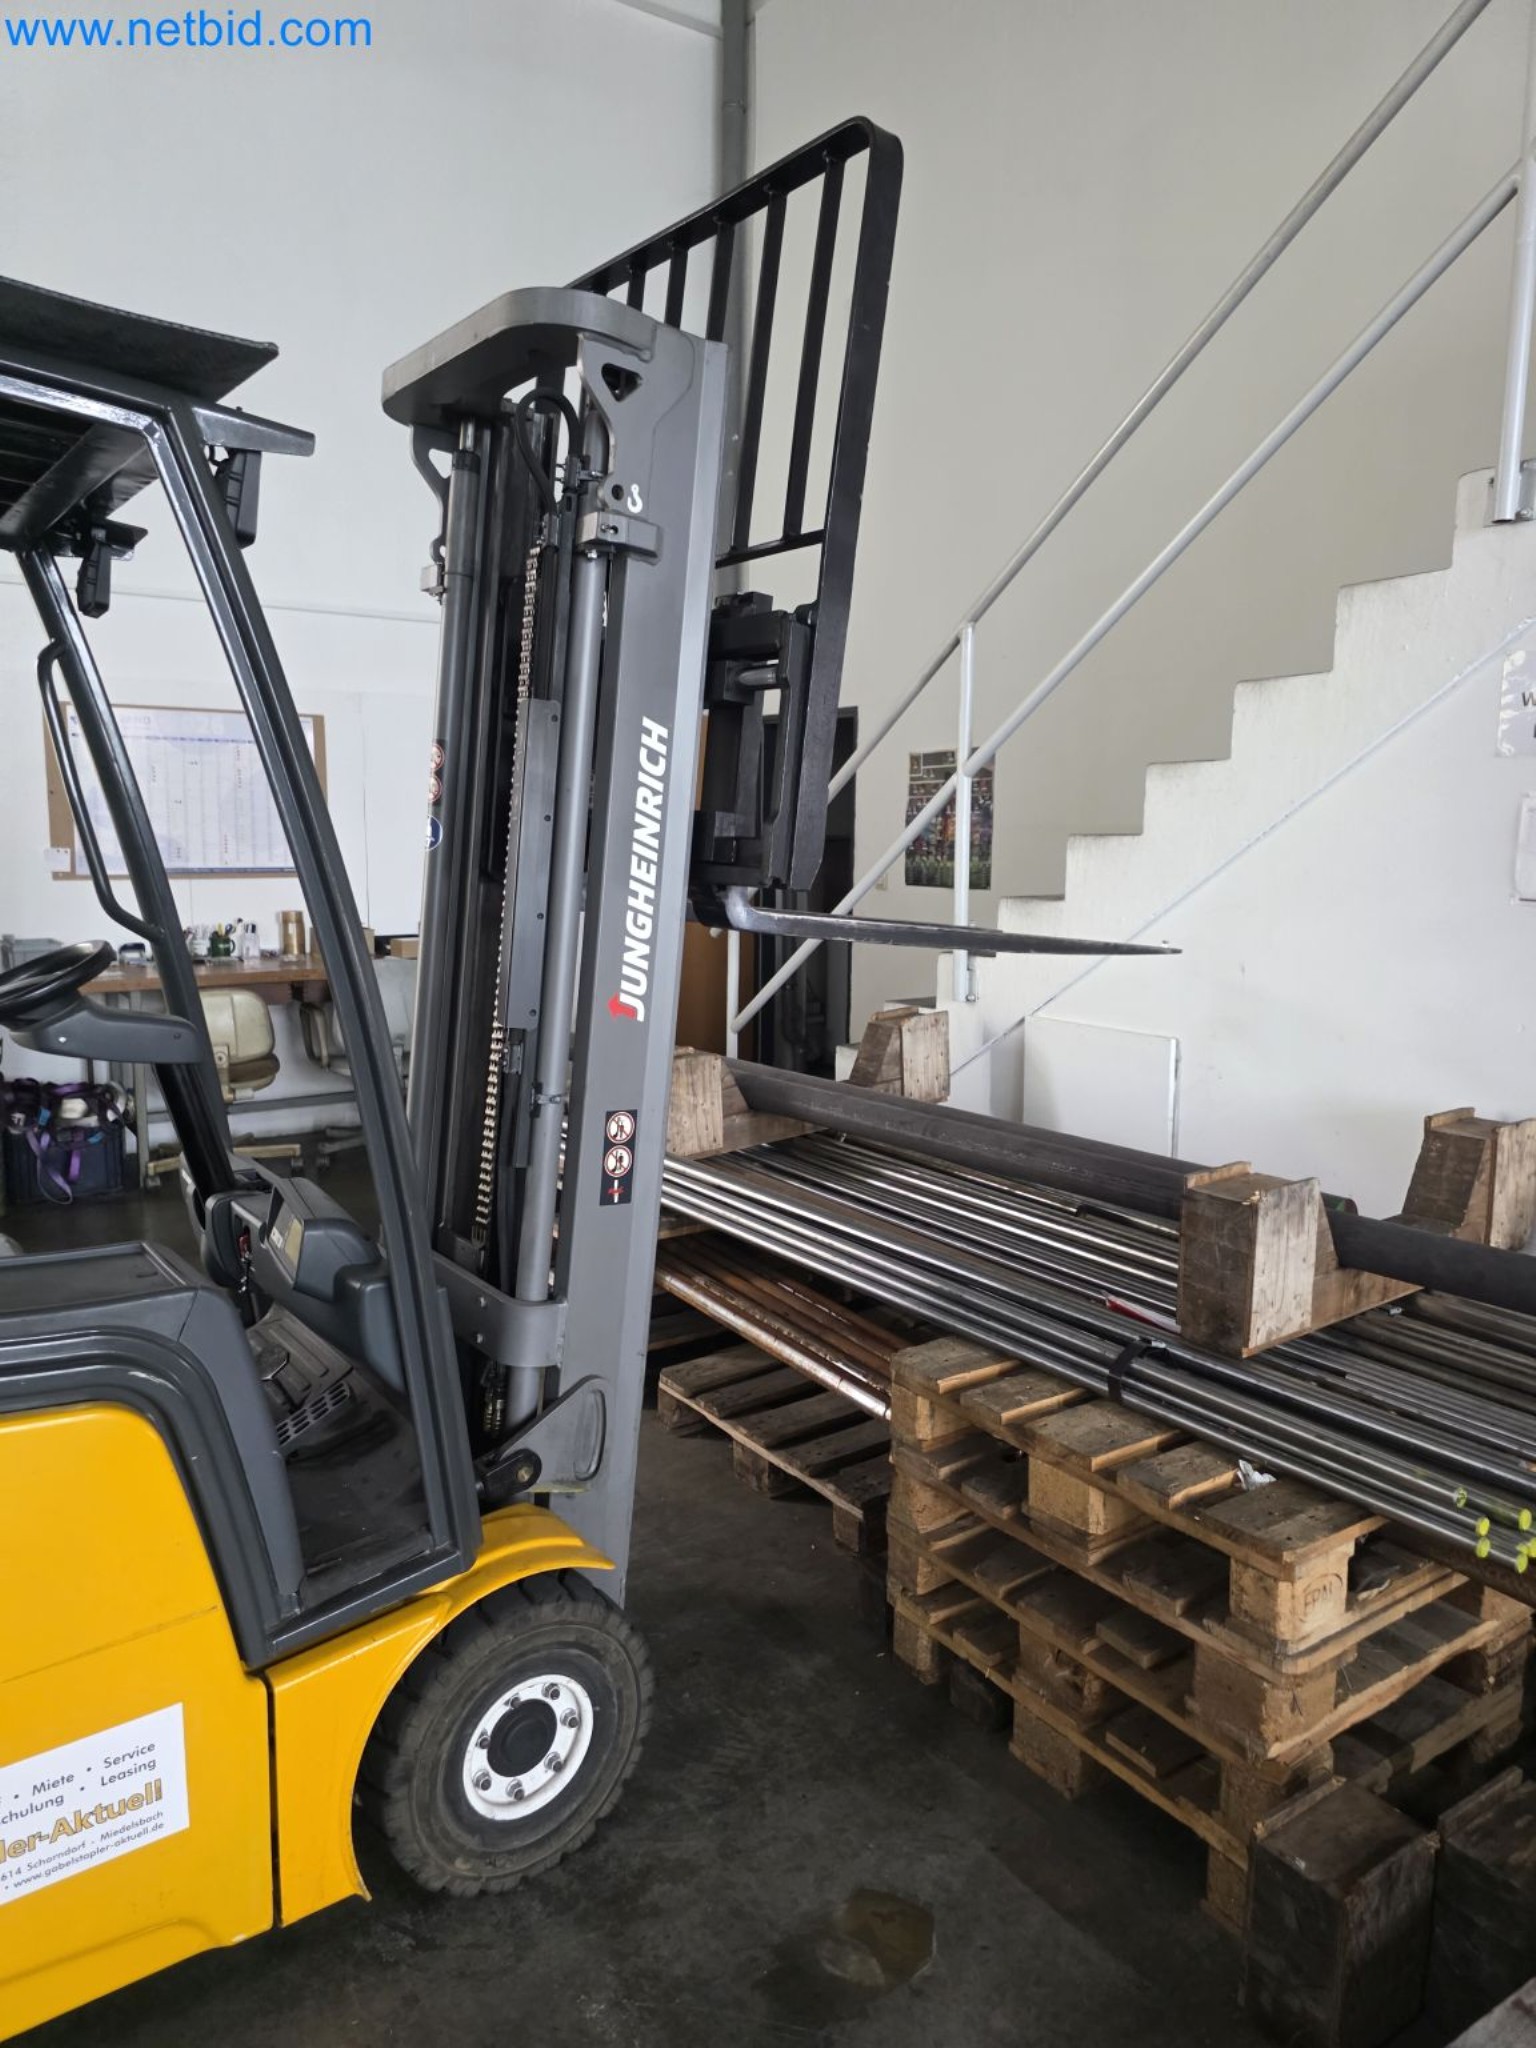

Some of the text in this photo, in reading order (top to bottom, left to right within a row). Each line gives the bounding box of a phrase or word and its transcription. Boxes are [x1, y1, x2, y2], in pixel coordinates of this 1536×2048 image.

[608, 715, 669, 1021] JUNGHEINRICH
[0, 1759, 157, 1826] chulung Leasing
[32, 1743, 156, 1796] Miete Service
[13, 1823, 164, 1889] www.gabelstapler-aktuell.de
[27, 1841, 86, 1872] Schorndorf
[100, 1811, 163, 1841] Miedelsbach
